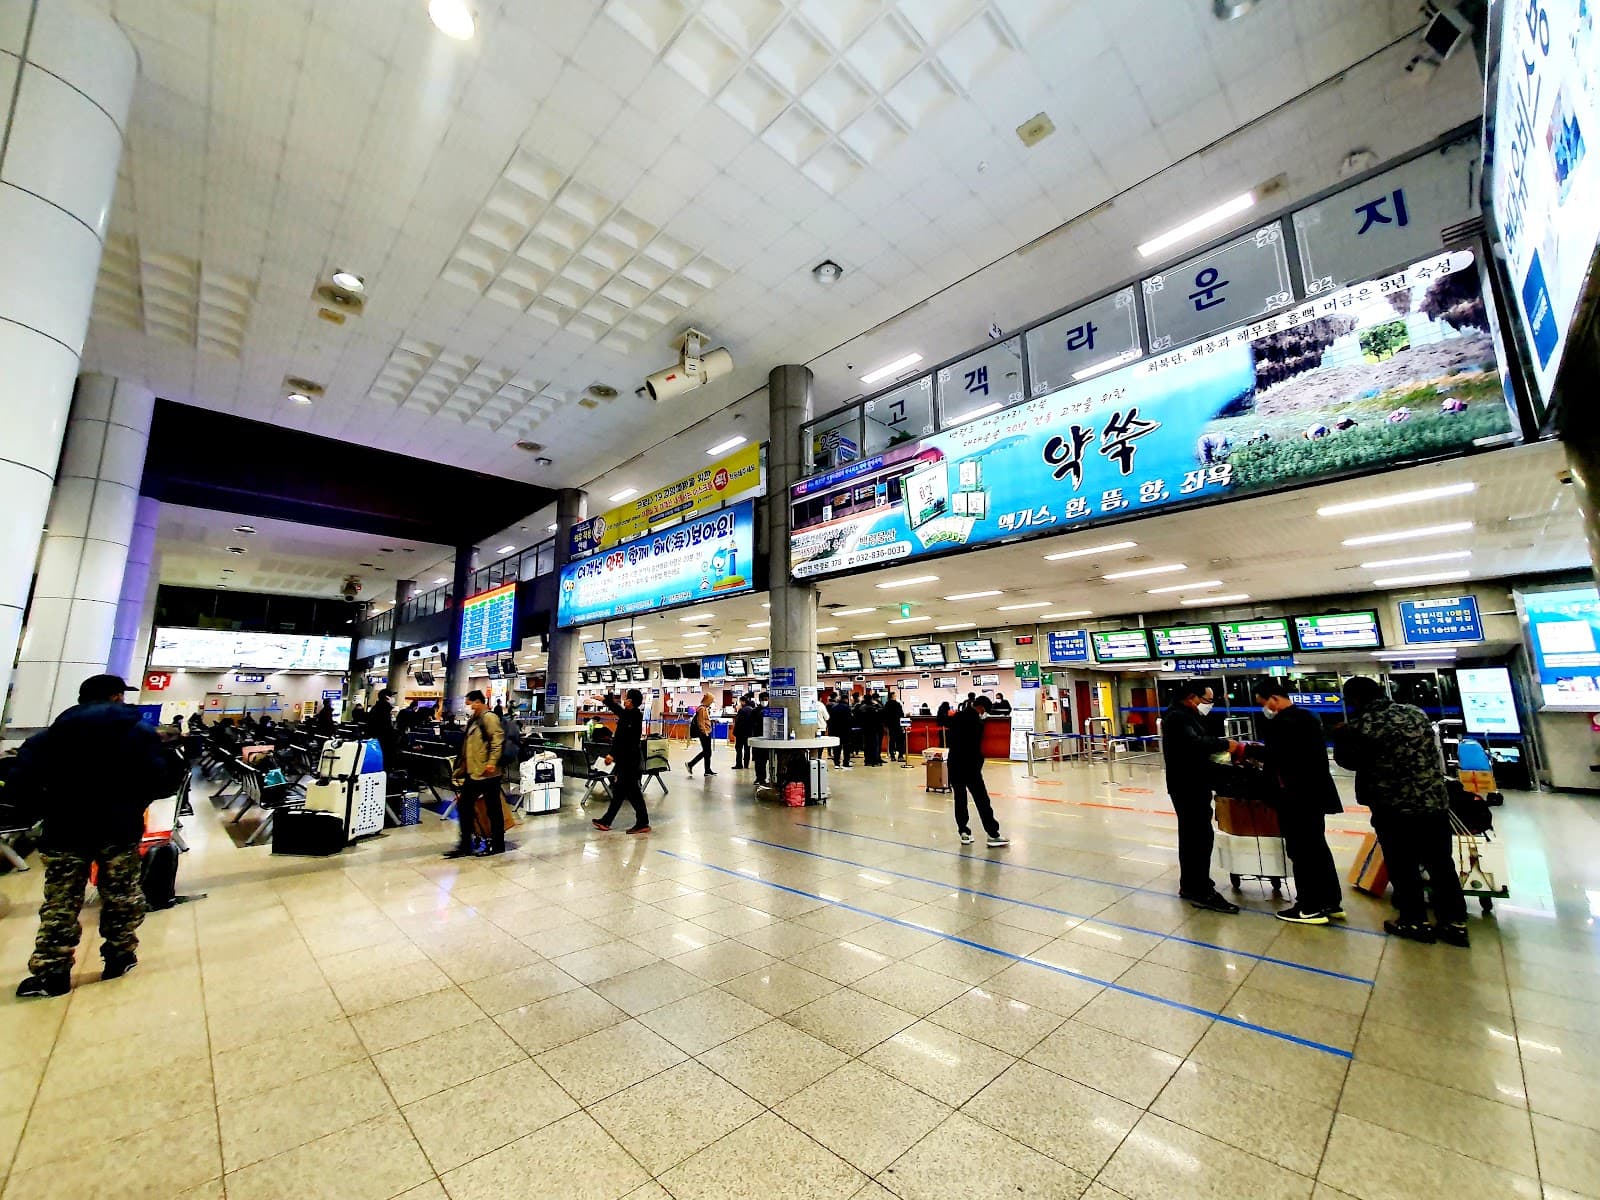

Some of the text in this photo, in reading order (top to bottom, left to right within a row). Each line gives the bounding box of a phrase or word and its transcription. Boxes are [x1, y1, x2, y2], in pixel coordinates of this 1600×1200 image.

[1192, 336, 1231, 357] 해풍과
[1324, 288, 1373, 310] 머금은
[1380, 274, 1407, 293] 3년
[1416, 258, 1452, 280] 숙성
[1060, 397, 1094, 417] 고객을
[1043, 406, 1162, 491] 약쑥
[1180, 462, 1234, 493] 좌욕
[577, 558, 604, 580] 여객선
[605, 551, 625, 572] 안전
[628, 545, 650, 566] 함께
[150, 675, 166, 689] 약
